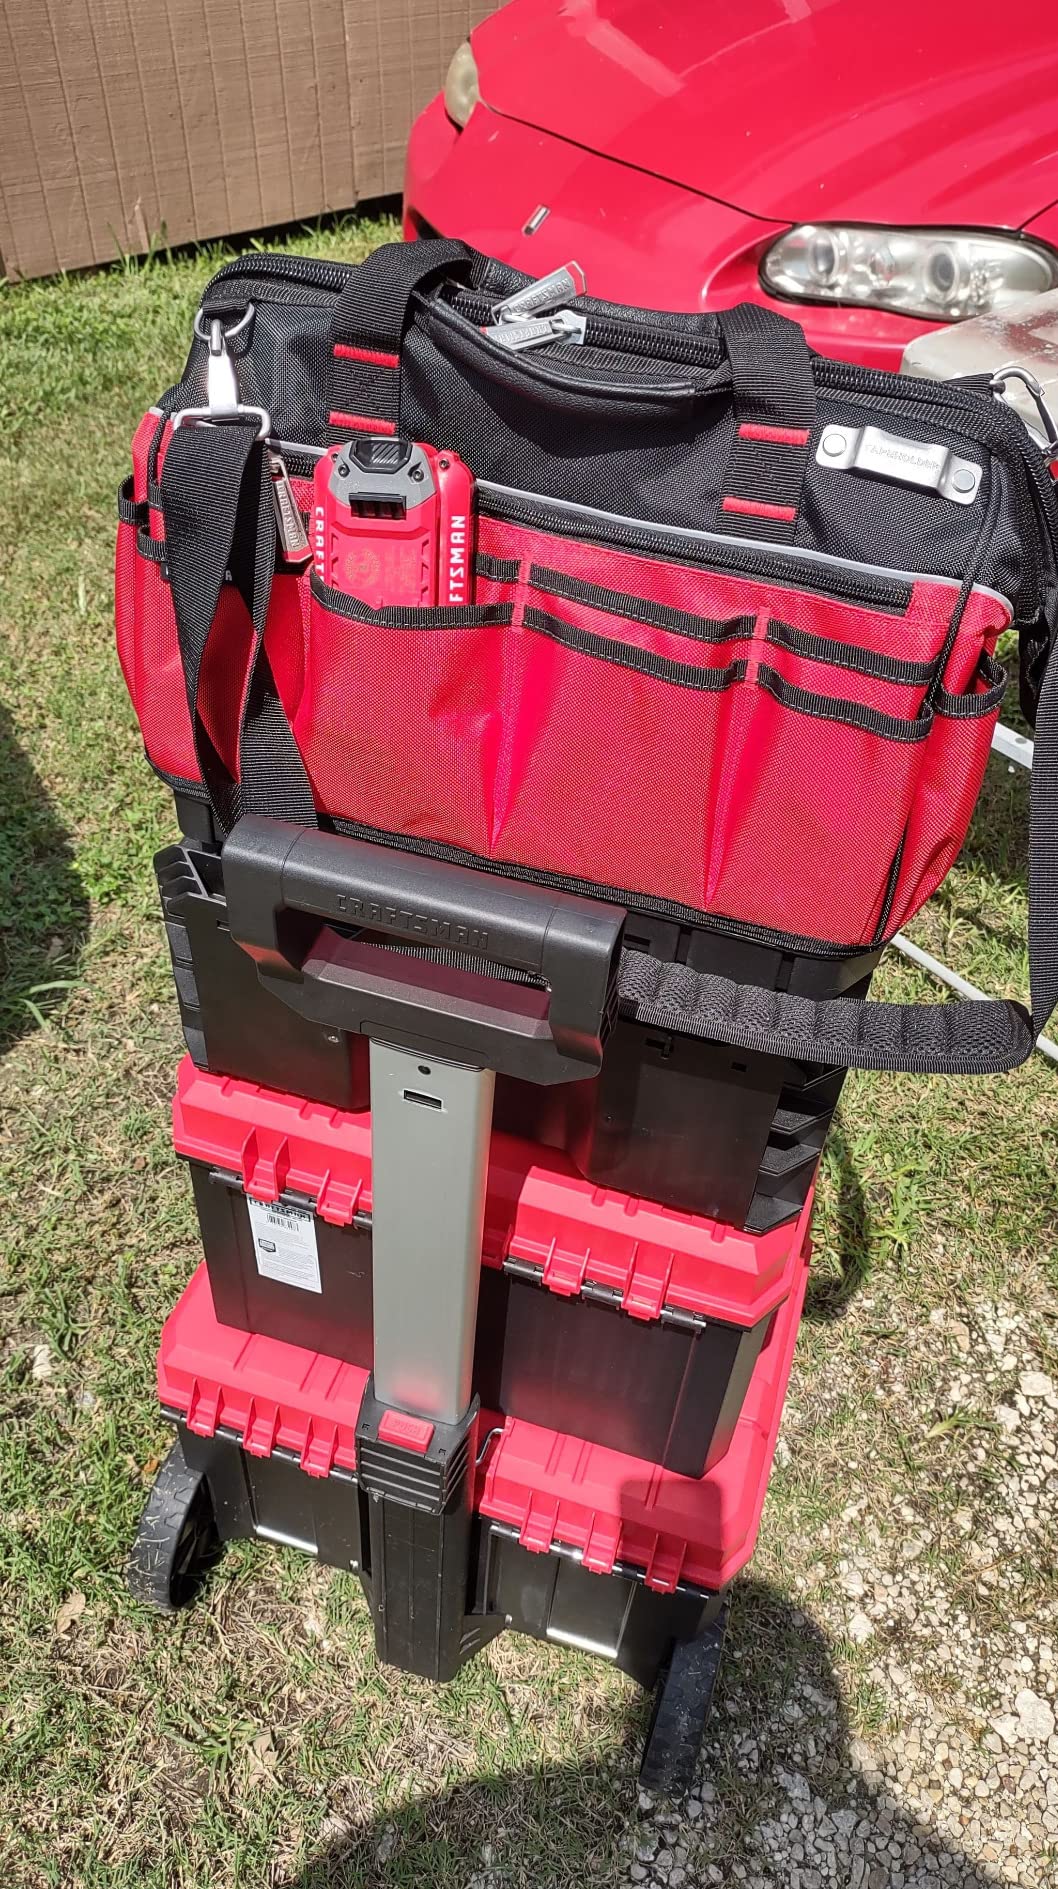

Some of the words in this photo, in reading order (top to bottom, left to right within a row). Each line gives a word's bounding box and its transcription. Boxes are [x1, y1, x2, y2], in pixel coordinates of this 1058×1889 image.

[513, 278, 570, 313] CRAFTSMAN
[449, 515, 467, 602] FTSMAN
[336, 894, 489, 950] CRAFTSMAN
